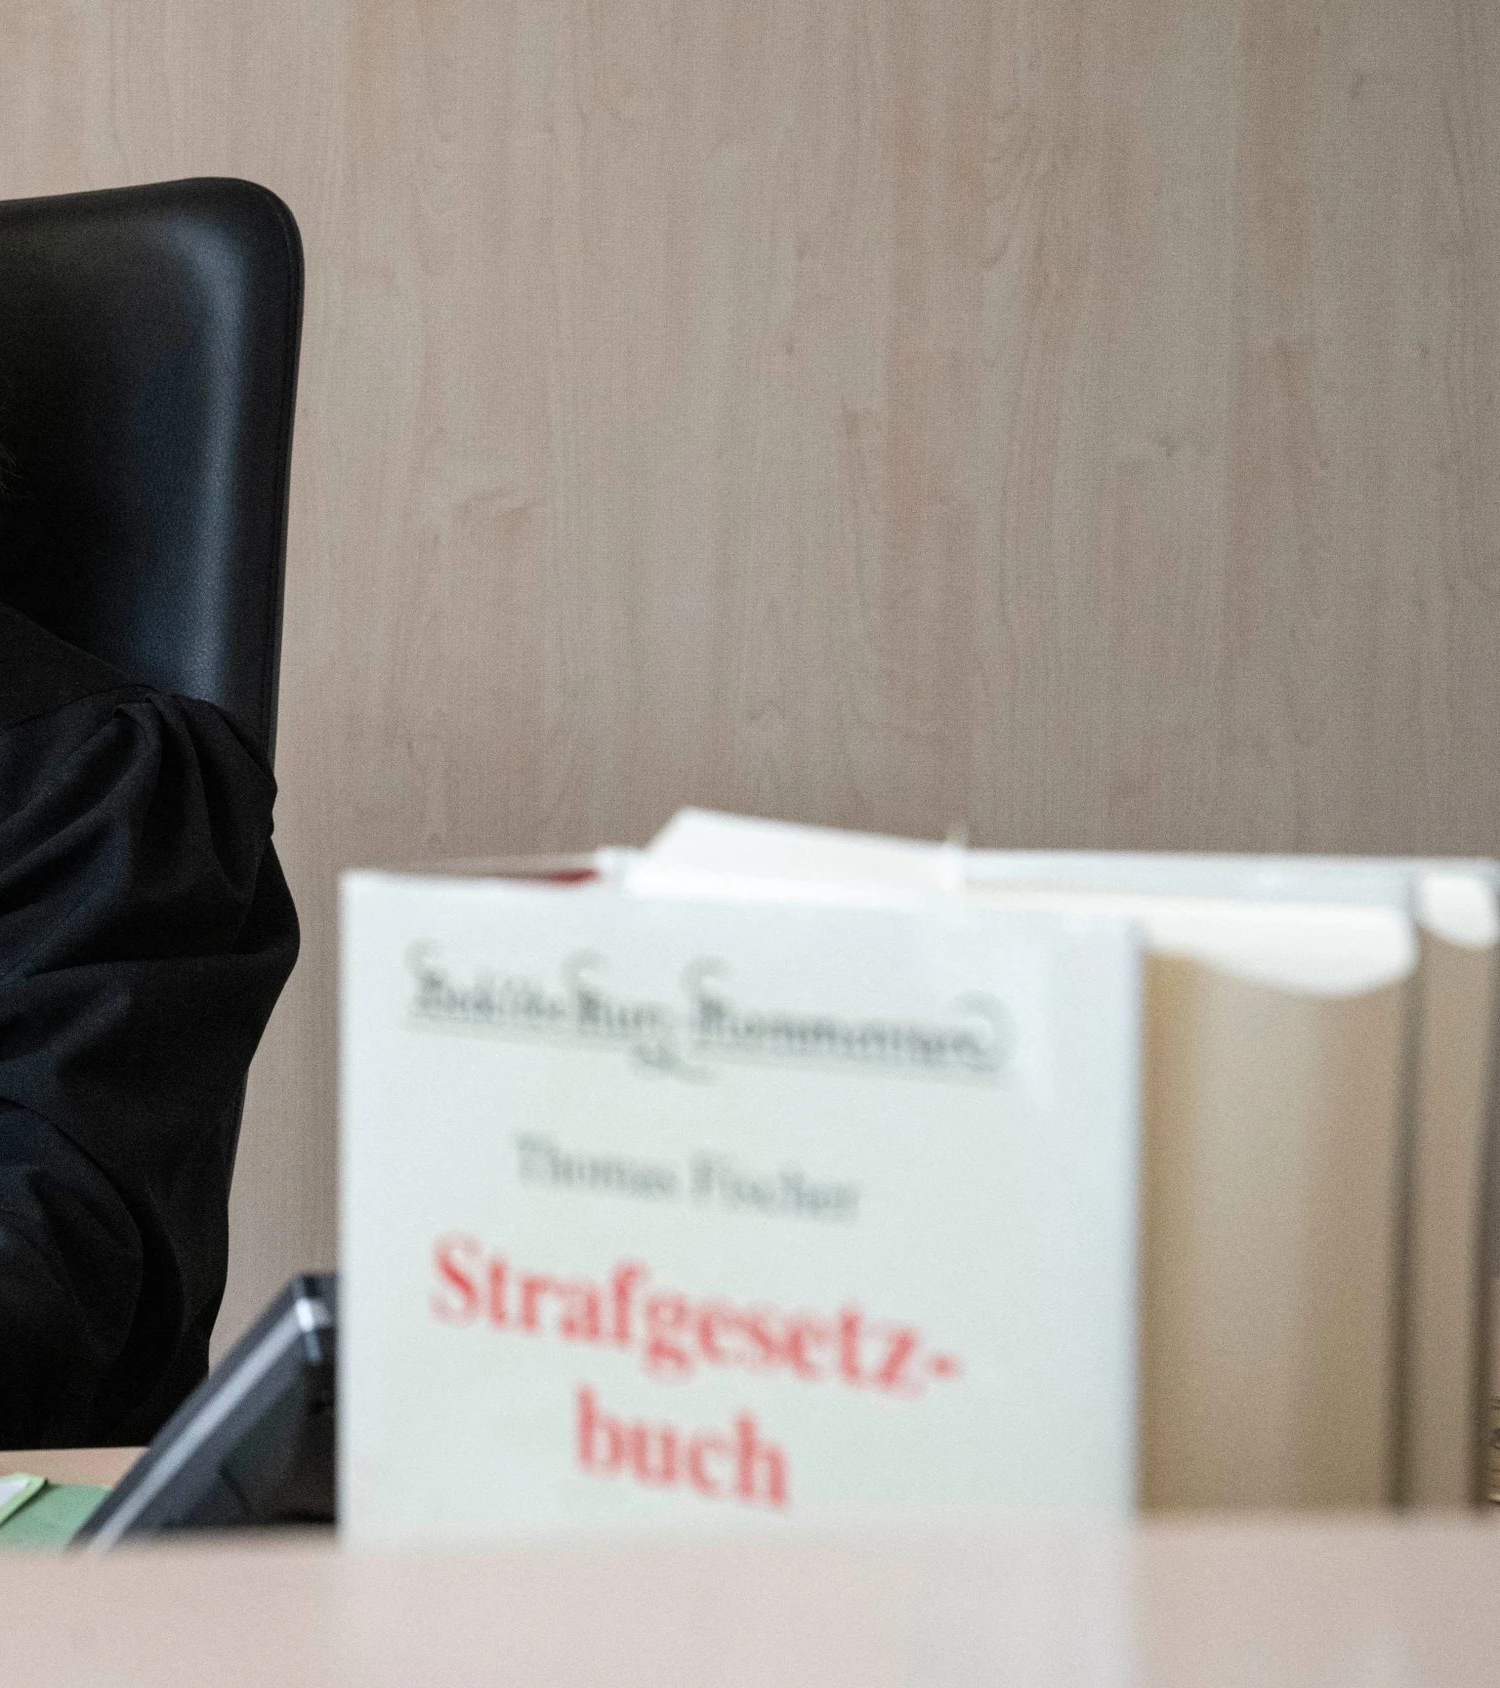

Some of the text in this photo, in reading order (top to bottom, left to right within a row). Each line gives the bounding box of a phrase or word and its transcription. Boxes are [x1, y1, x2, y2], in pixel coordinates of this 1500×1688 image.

[513, 1131, 862, 1225] Thomas Fischer
[430, 1234, 960, 1396] Strafgesetz-
[575, 1385, 790, 1508] buch
